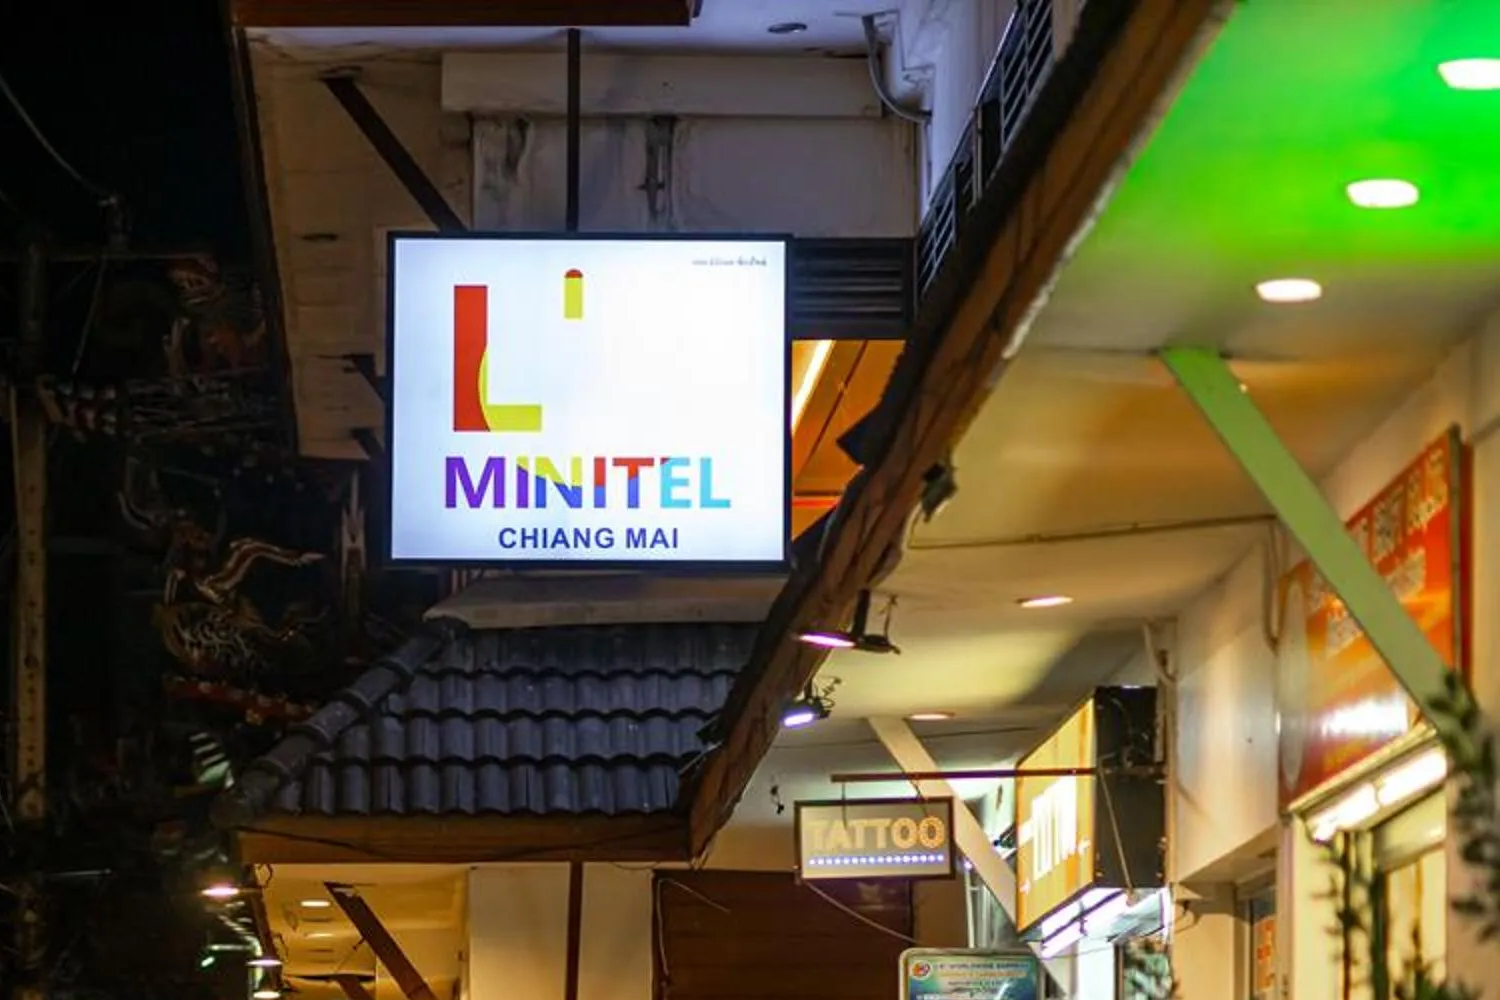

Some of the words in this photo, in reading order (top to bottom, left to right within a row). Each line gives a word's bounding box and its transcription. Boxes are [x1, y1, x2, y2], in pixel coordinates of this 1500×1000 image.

[445, 456, 731, 508] MINITEL
[498, 527, 614, 549] CHIANG
[625, 527, 678, 549] MAI
[809, 815, 945, 850] TATTOO
